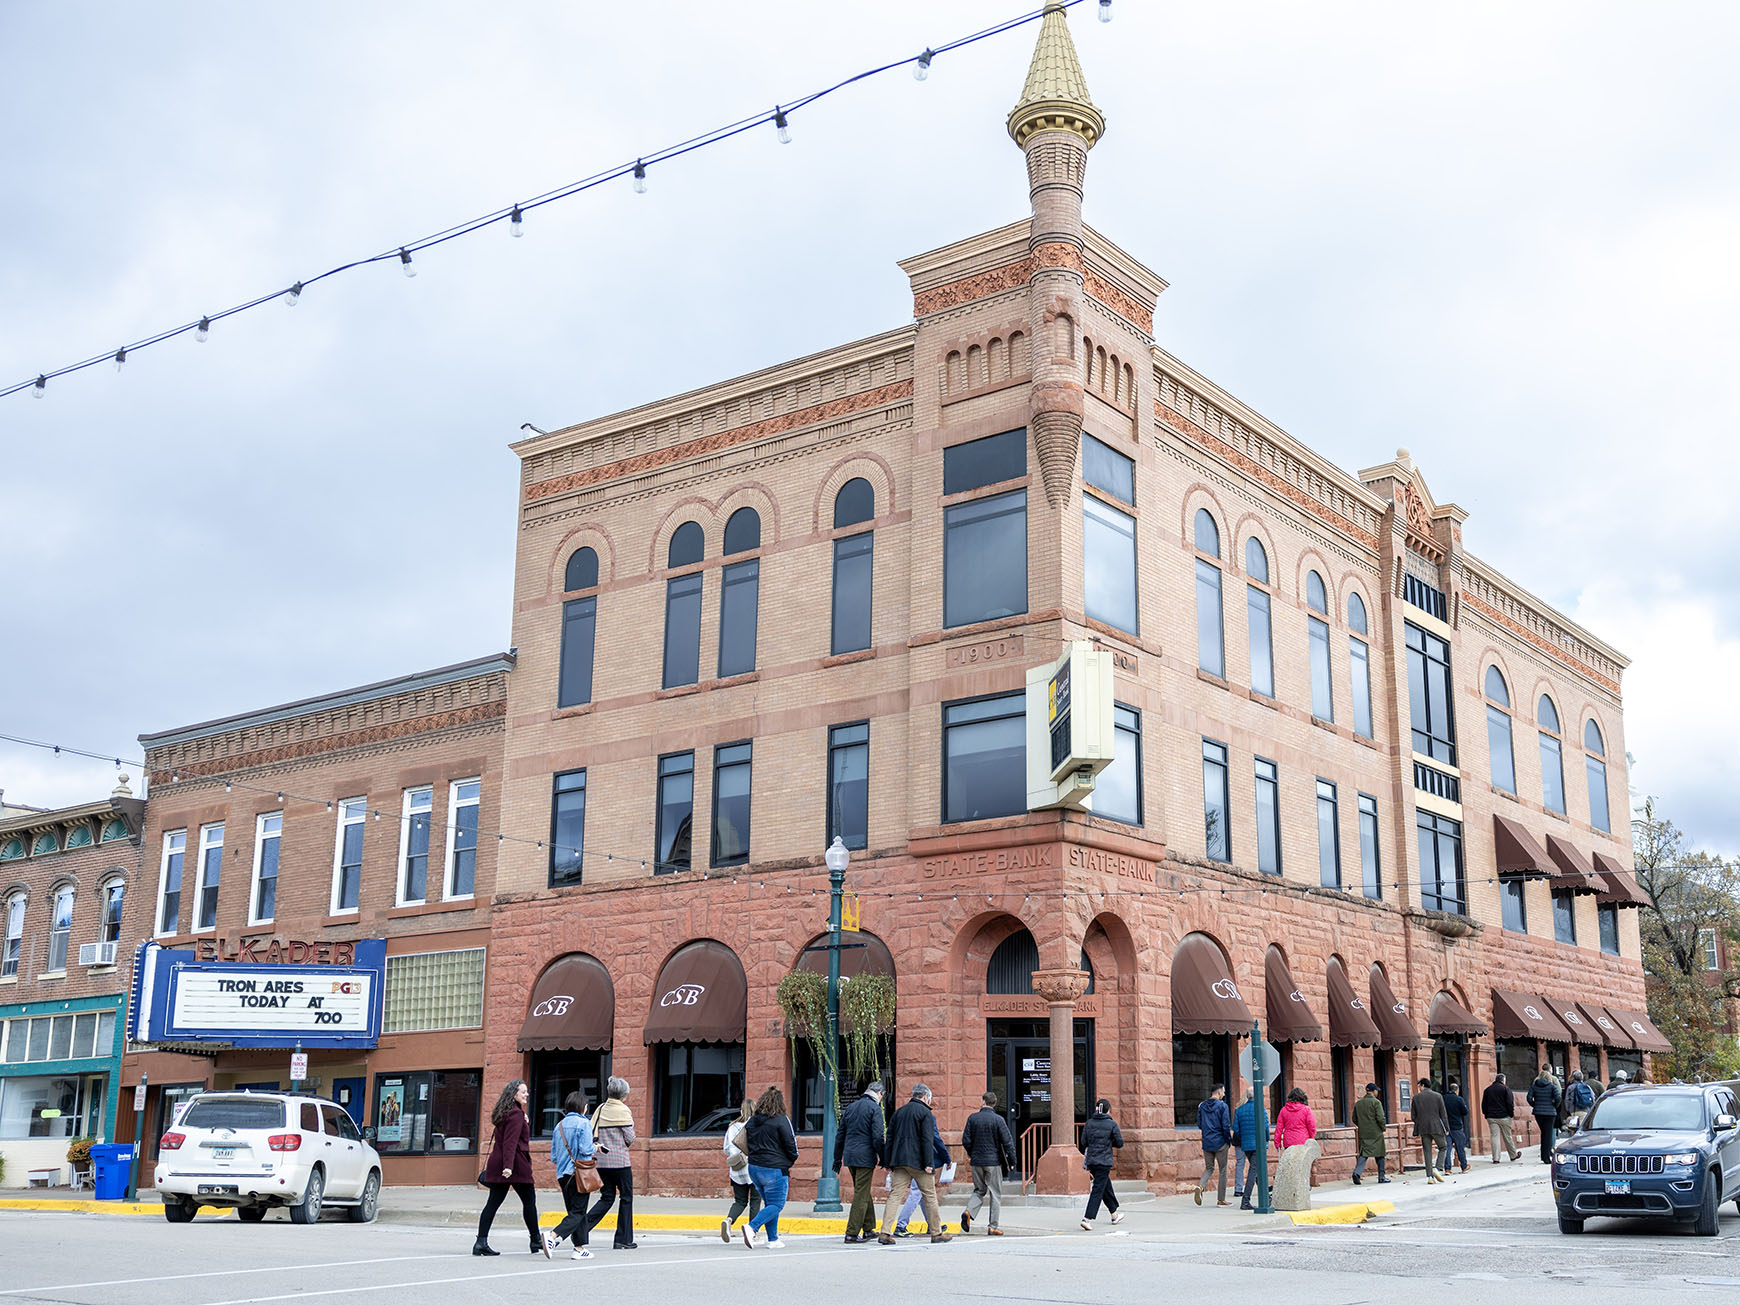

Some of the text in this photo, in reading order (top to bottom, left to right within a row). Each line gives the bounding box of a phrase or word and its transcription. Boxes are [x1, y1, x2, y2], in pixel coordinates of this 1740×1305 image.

[195, 938, 354, 965] ELKADER
[218, 979, 257, 993] TRON
[263, 981, 304, 994] ARES
[239, 995, 325, 1009] TODAY AT
[660, 984, 706, 1007] CSB
[533, 995, 575, 1017] CSB
[983, 1001, 1030, 1013] ELKADER
[314, 1011, 343, 1024] 700
